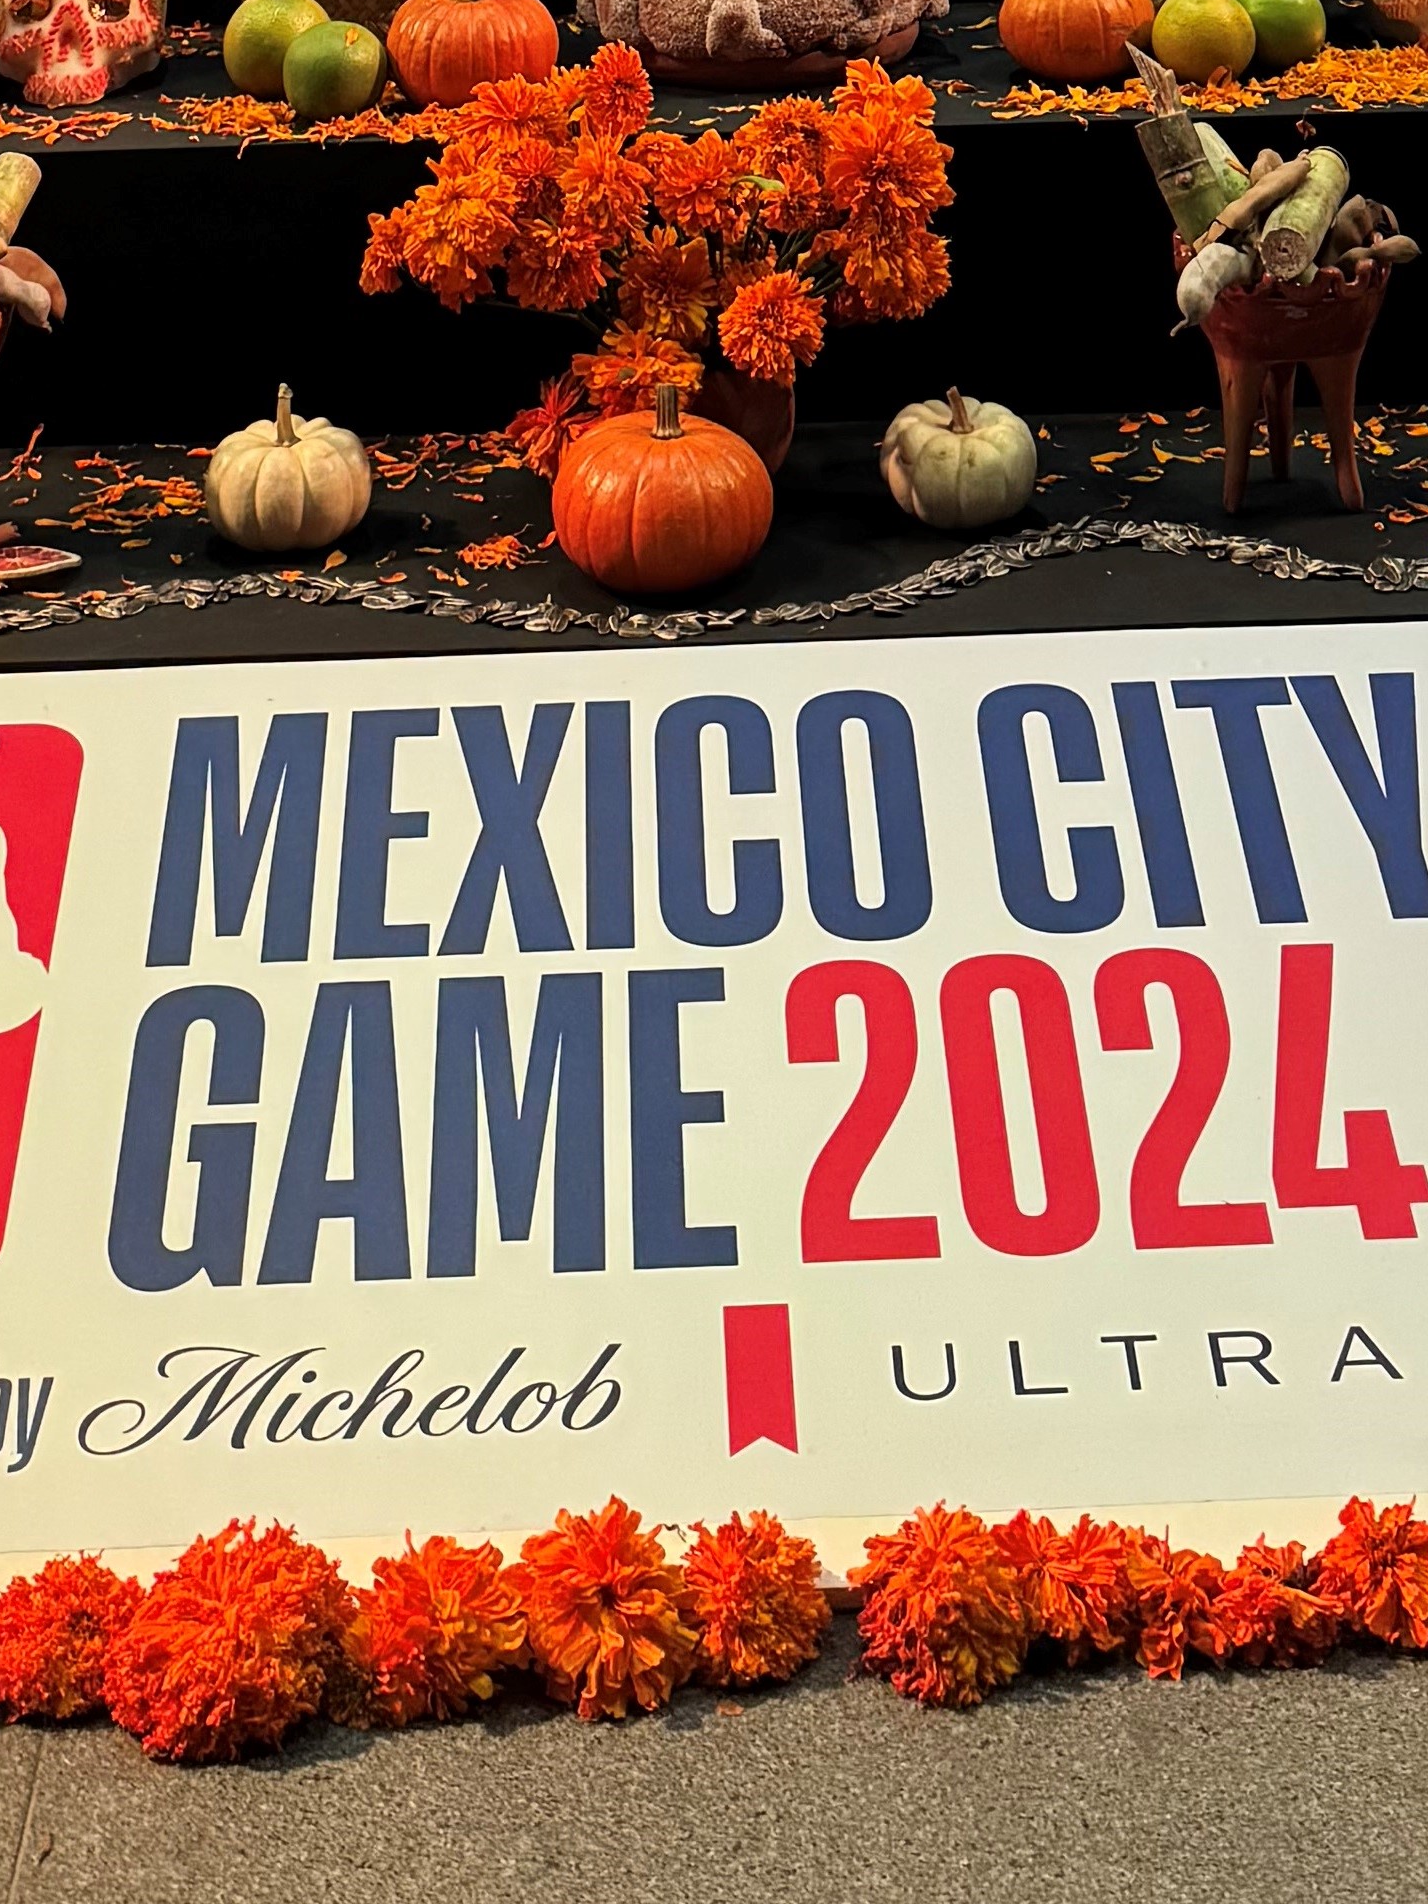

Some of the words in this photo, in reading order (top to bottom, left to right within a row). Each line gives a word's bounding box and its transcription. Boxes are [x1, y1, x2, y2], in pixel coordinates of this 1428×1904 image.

[145, 684, 929, 969] MEXICO
[105, 965, 740, 1294] GAME
[78, 1337, 623, 1460] Michelob
[891, 1322, 1406, 1403] ULTRA
